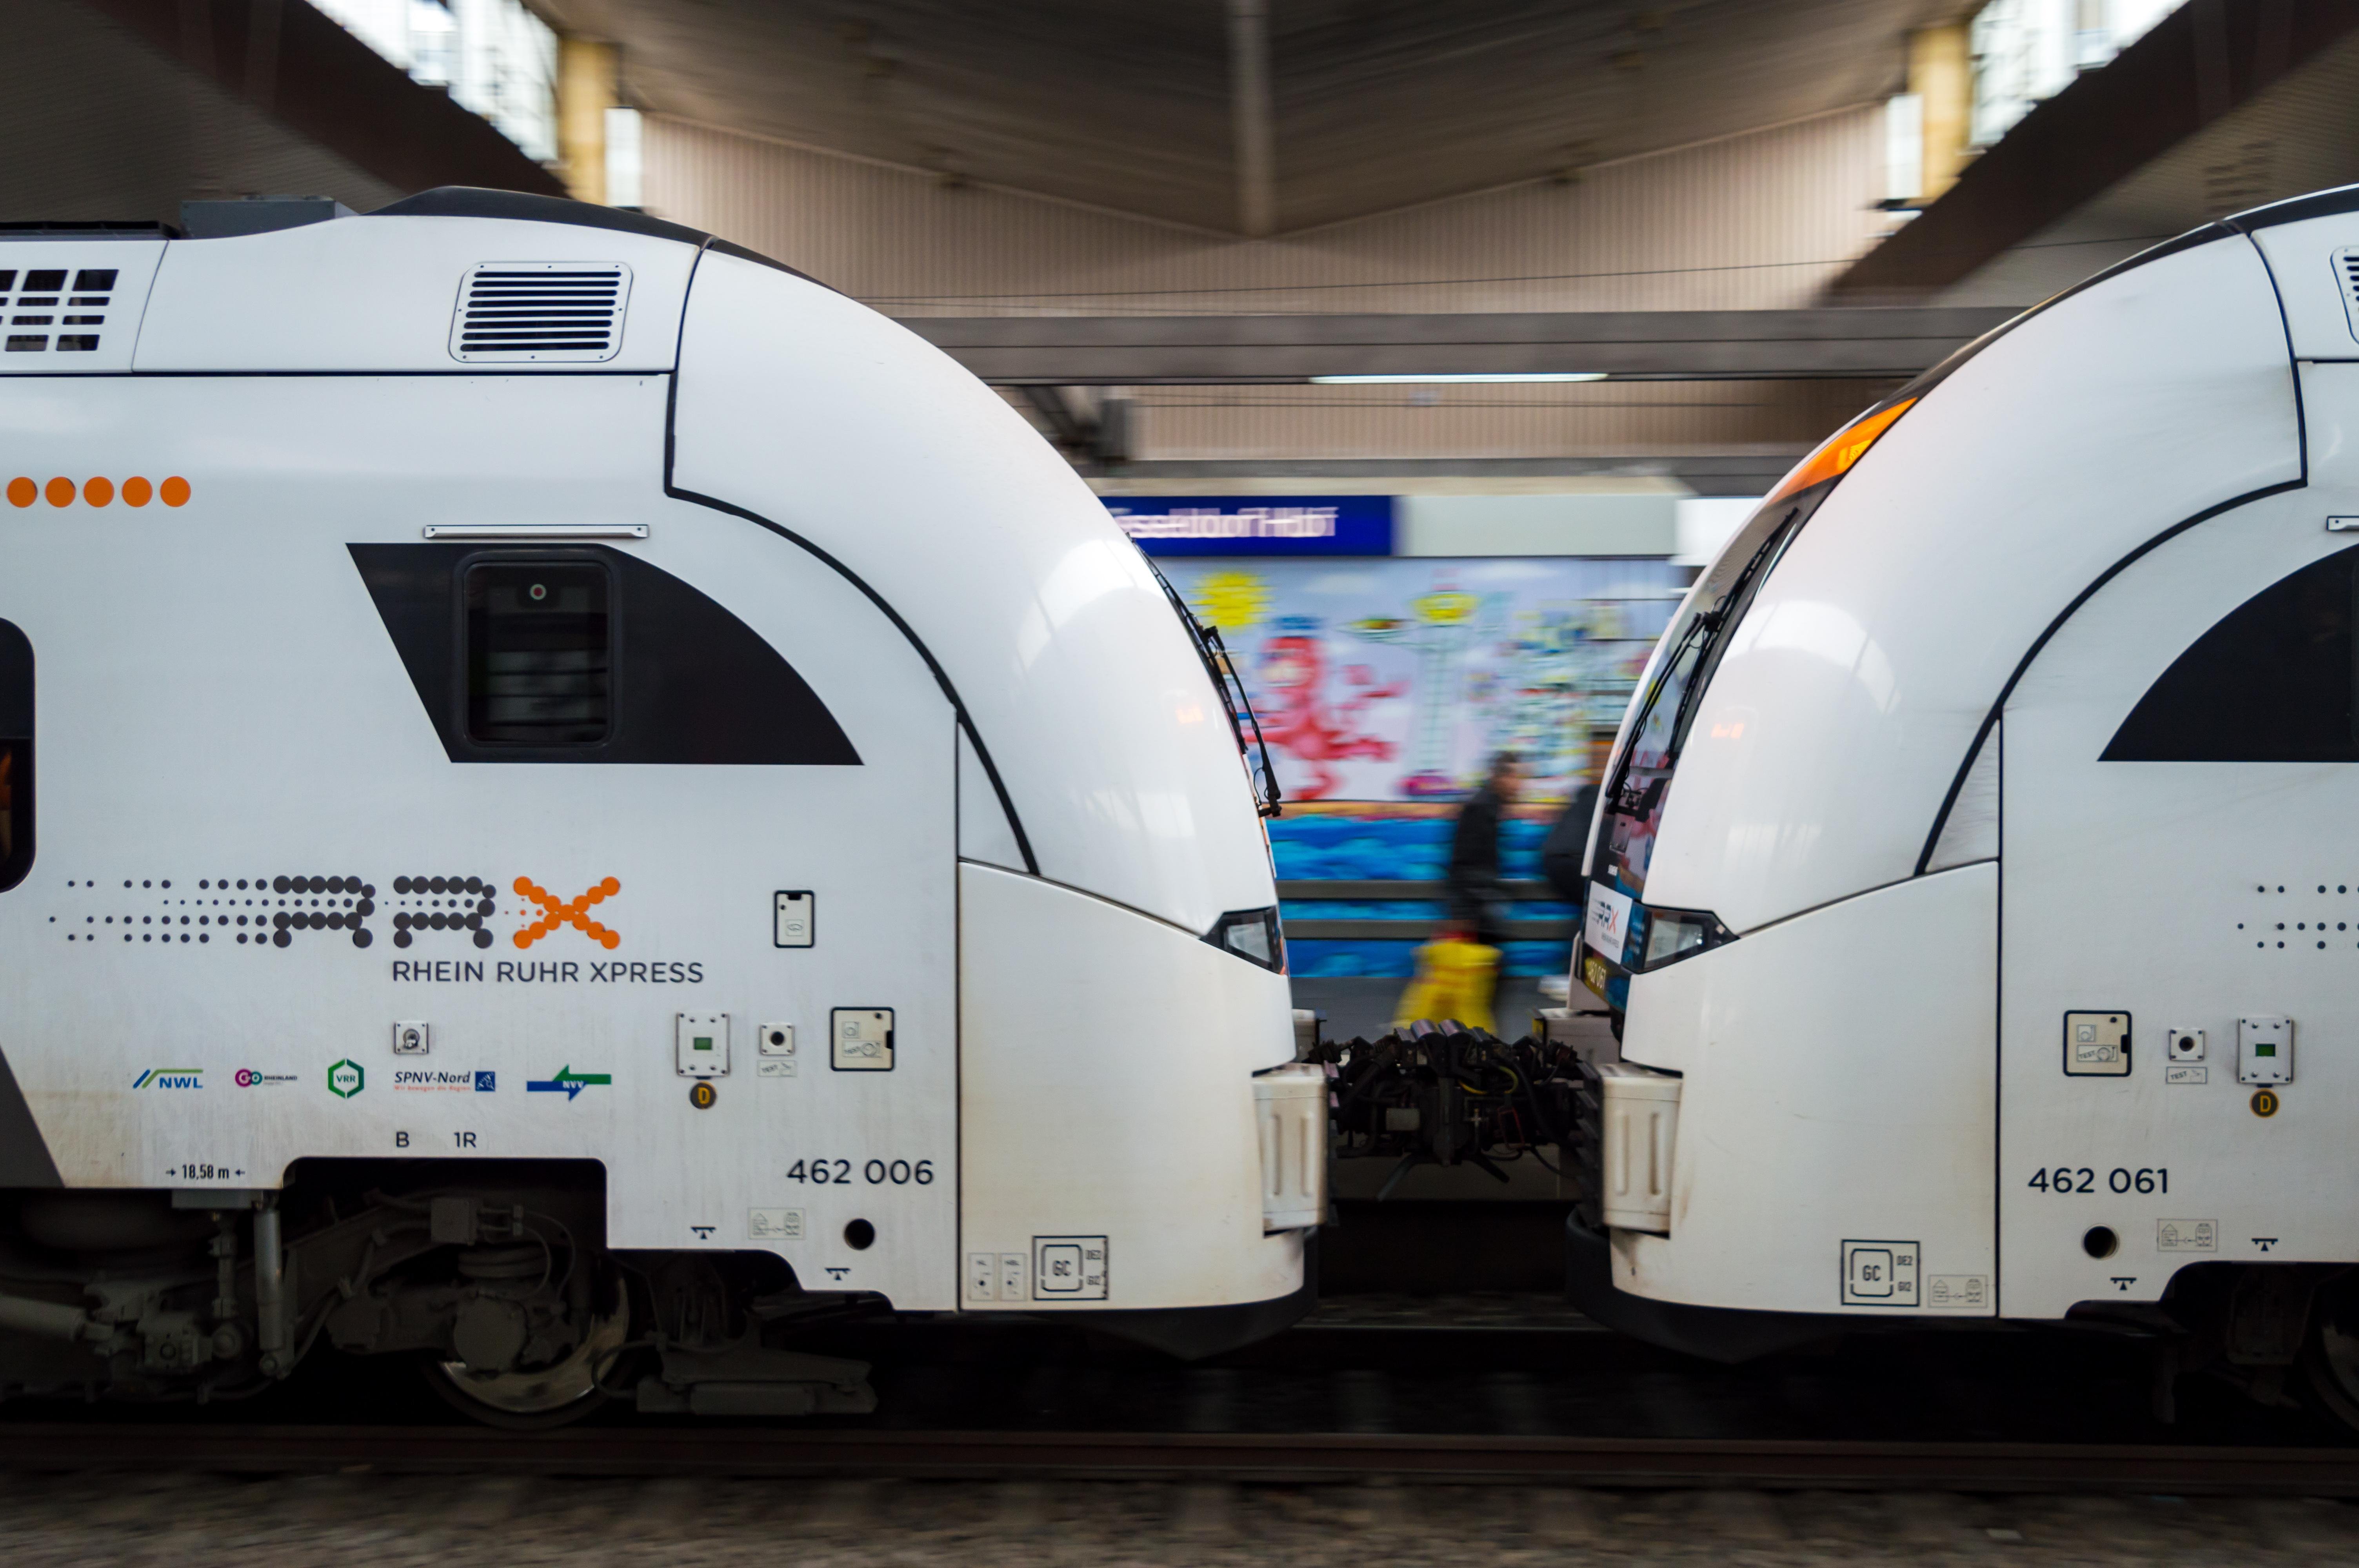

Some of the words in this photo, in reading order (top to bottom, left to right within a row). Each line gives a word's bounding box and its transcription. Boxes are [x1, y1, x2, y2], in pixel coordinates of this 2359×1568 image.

[393, 961, 483, 983] RHEIN
[497, 961, 578, 983] RUHR
[590, 961, 703, 983] XPRESS
[2079, 1050, 2095, 1059] TEST
[159, 1077, 203, 1088] NWL
[395, 1071, 471, 1083] SPNV-Nord
[2170, 1071, 2187, 1080] TEST
[563, 1080, 583, 1089] NVV
[698, 1087, 711, 1104] D
[2260, 1095, 2271, 1112] D
[396, 1131, 410, 1147] B
[454, 1131, 477, 1147] 1R
[182, 1164, 214, 1180] 18,58
[218, 1168, 229, 1178] m
[787, 1159, 851, 1185] 462
[864, 1159, 934, 1185] 006
[2028, 1167, 2095, 1194] 462
[2109, 1167, 2167, 1194] 061
[1896, 1255, 1913, 1266] DE2
[1863, 1265, 1881, 1281] GC
